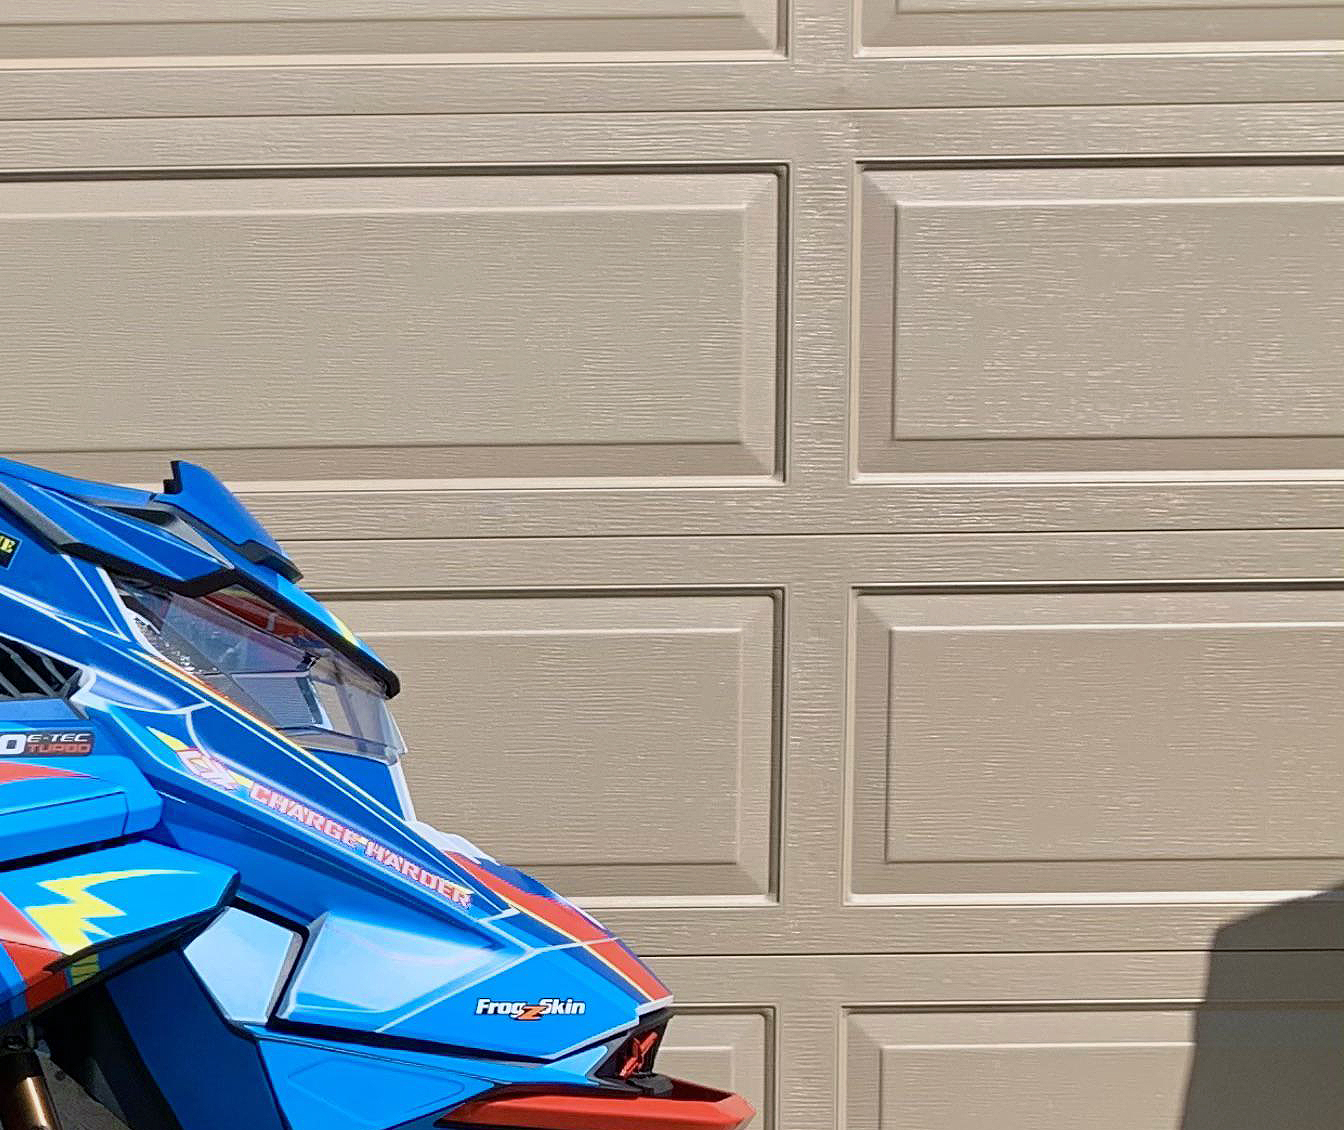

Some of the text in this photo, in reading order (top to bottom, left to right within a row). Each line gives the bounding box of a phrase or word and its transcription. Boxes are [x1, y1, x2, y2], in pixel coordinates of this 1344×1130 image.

[27, 733, 91, 742] E-TEC
[250, 783, 473, 906] CHARGE HARDER
